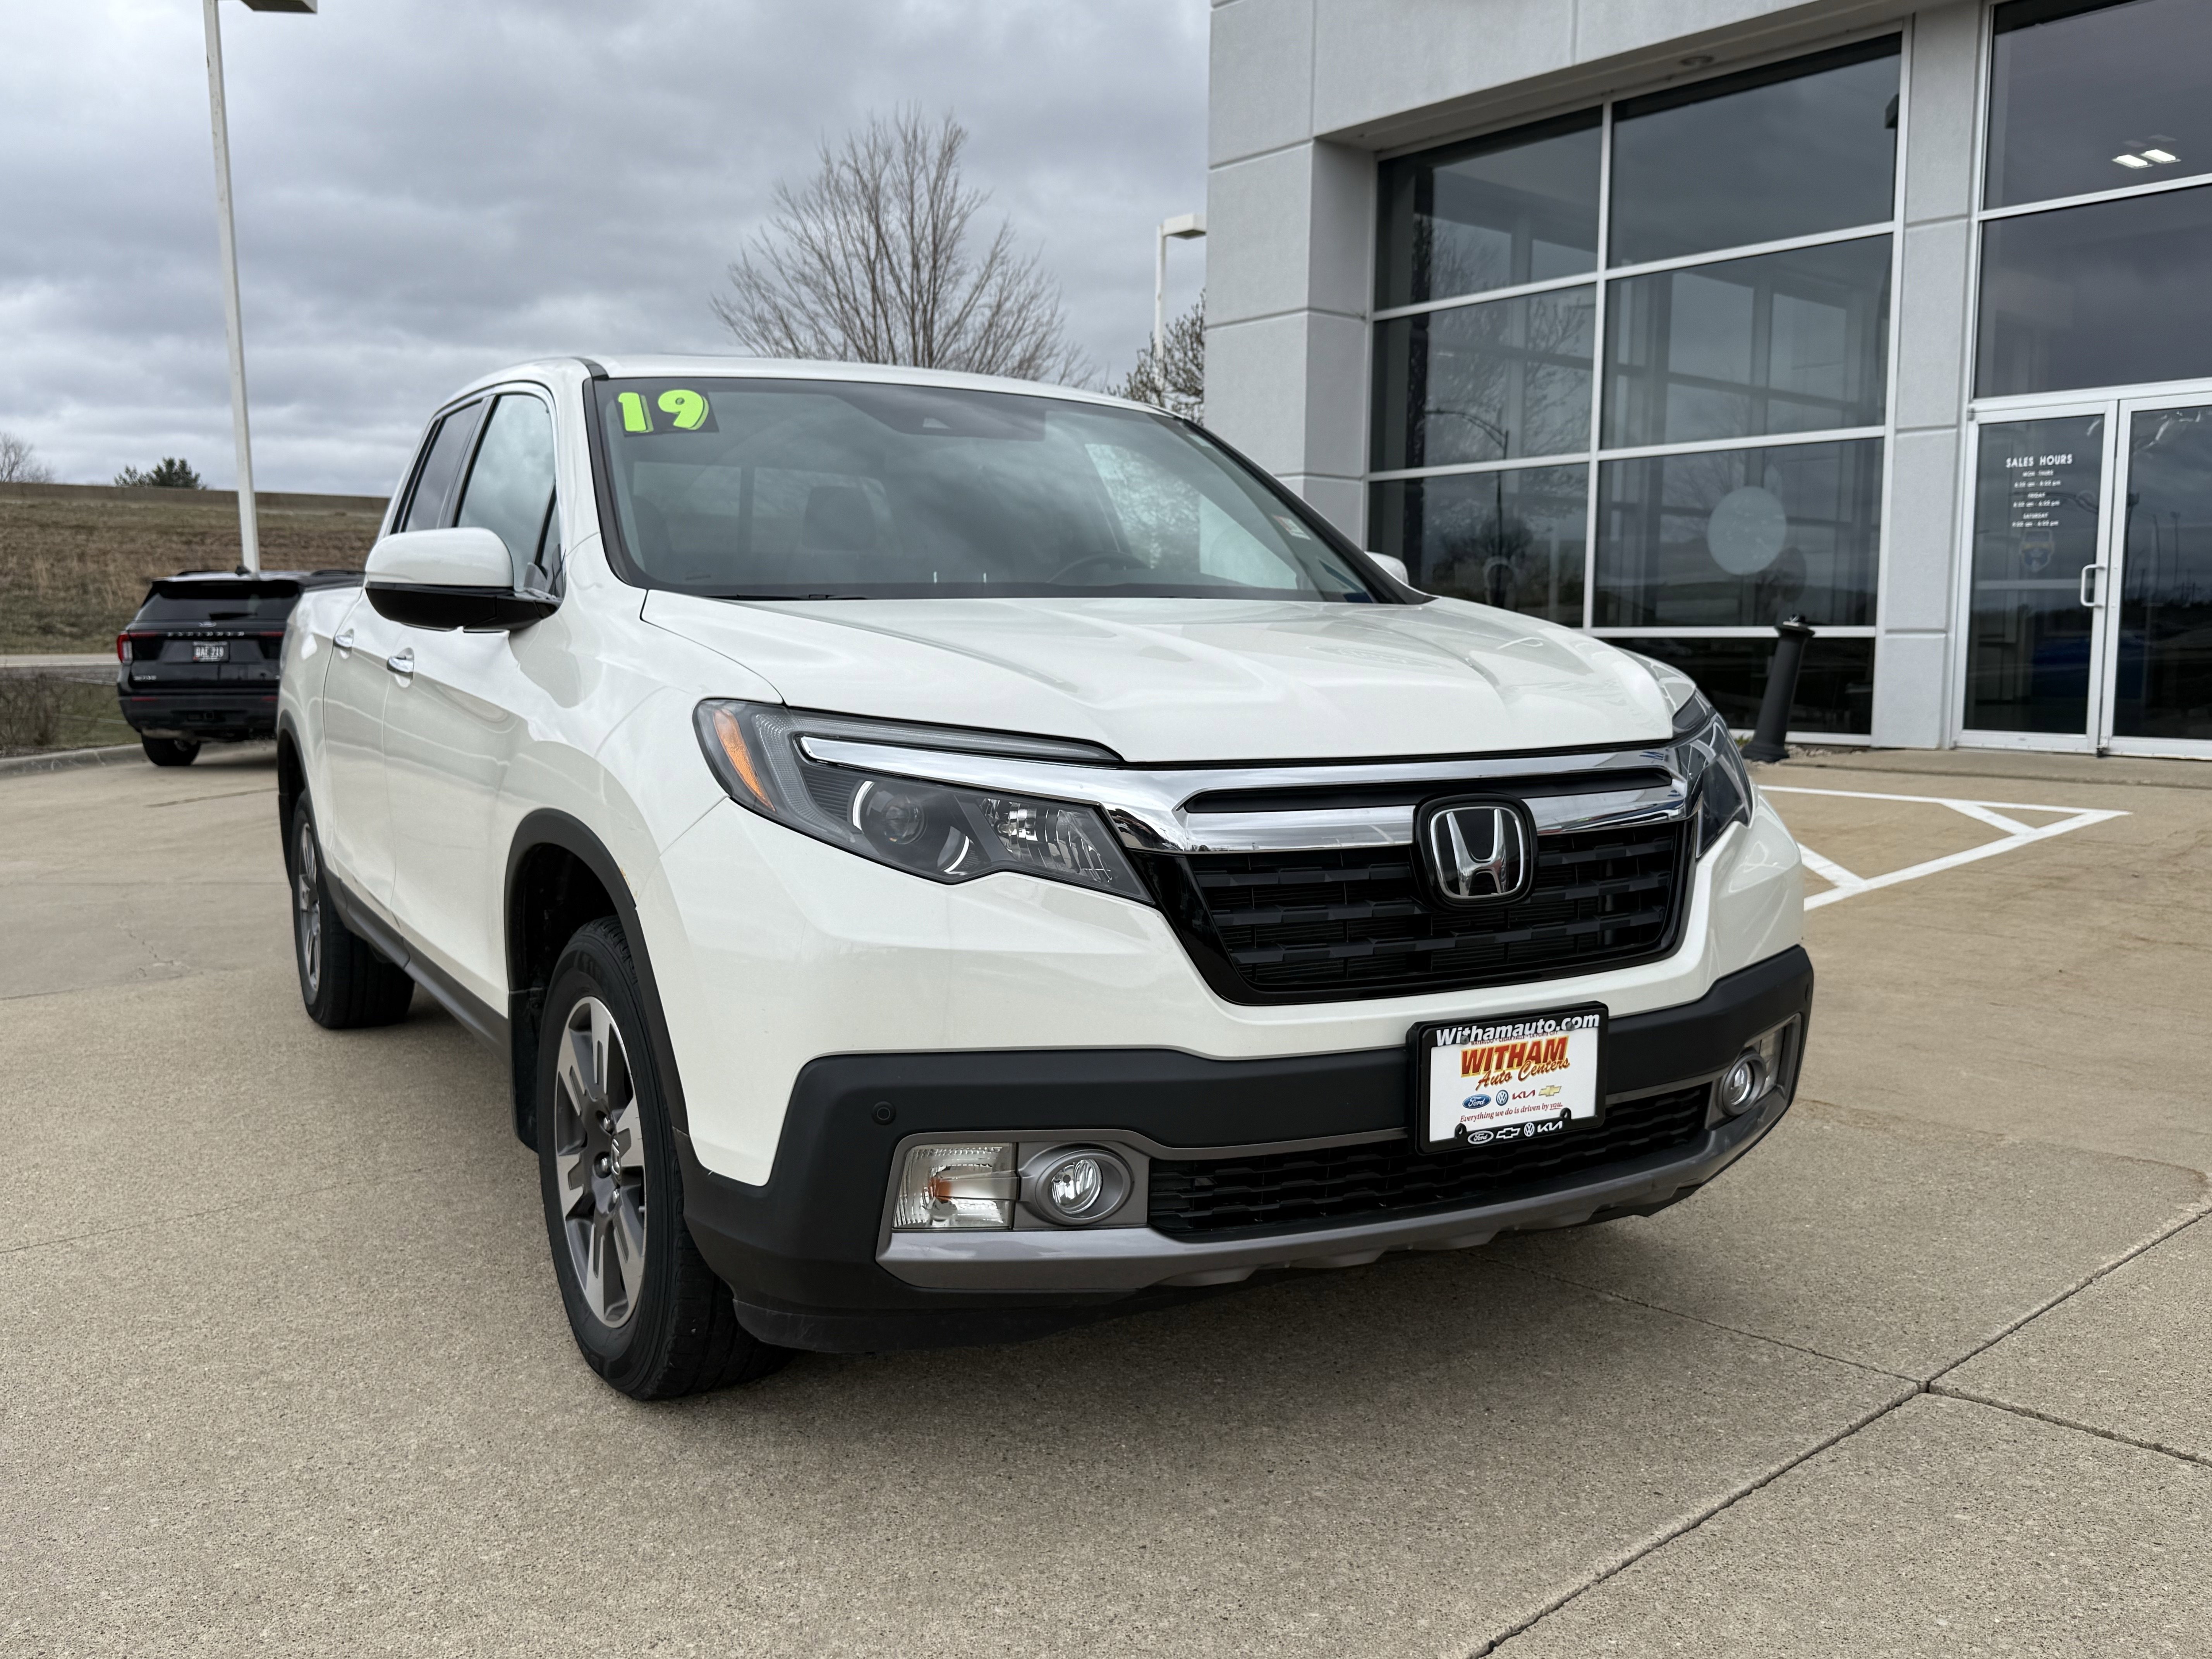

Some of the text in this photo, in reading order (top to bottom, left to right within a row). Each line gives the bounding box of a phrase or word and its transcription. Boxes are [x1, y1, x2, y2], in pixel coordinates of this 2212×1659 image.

[618, 389, 709, 432] 19
[2006, 454, 2072, 468] SALES HOURS
[1436, 1014, 1600, 1046] Withamauto.com
[1461, 1036, 1569, 1077] WITHAM
[1475, 1058, 1570, 1091] Auto Centers
[1460, 1112, 1494, 1122] Everything
[1520, 1104, 1540, 1113] driven
[1542, 1103, 1549, 1111] by
